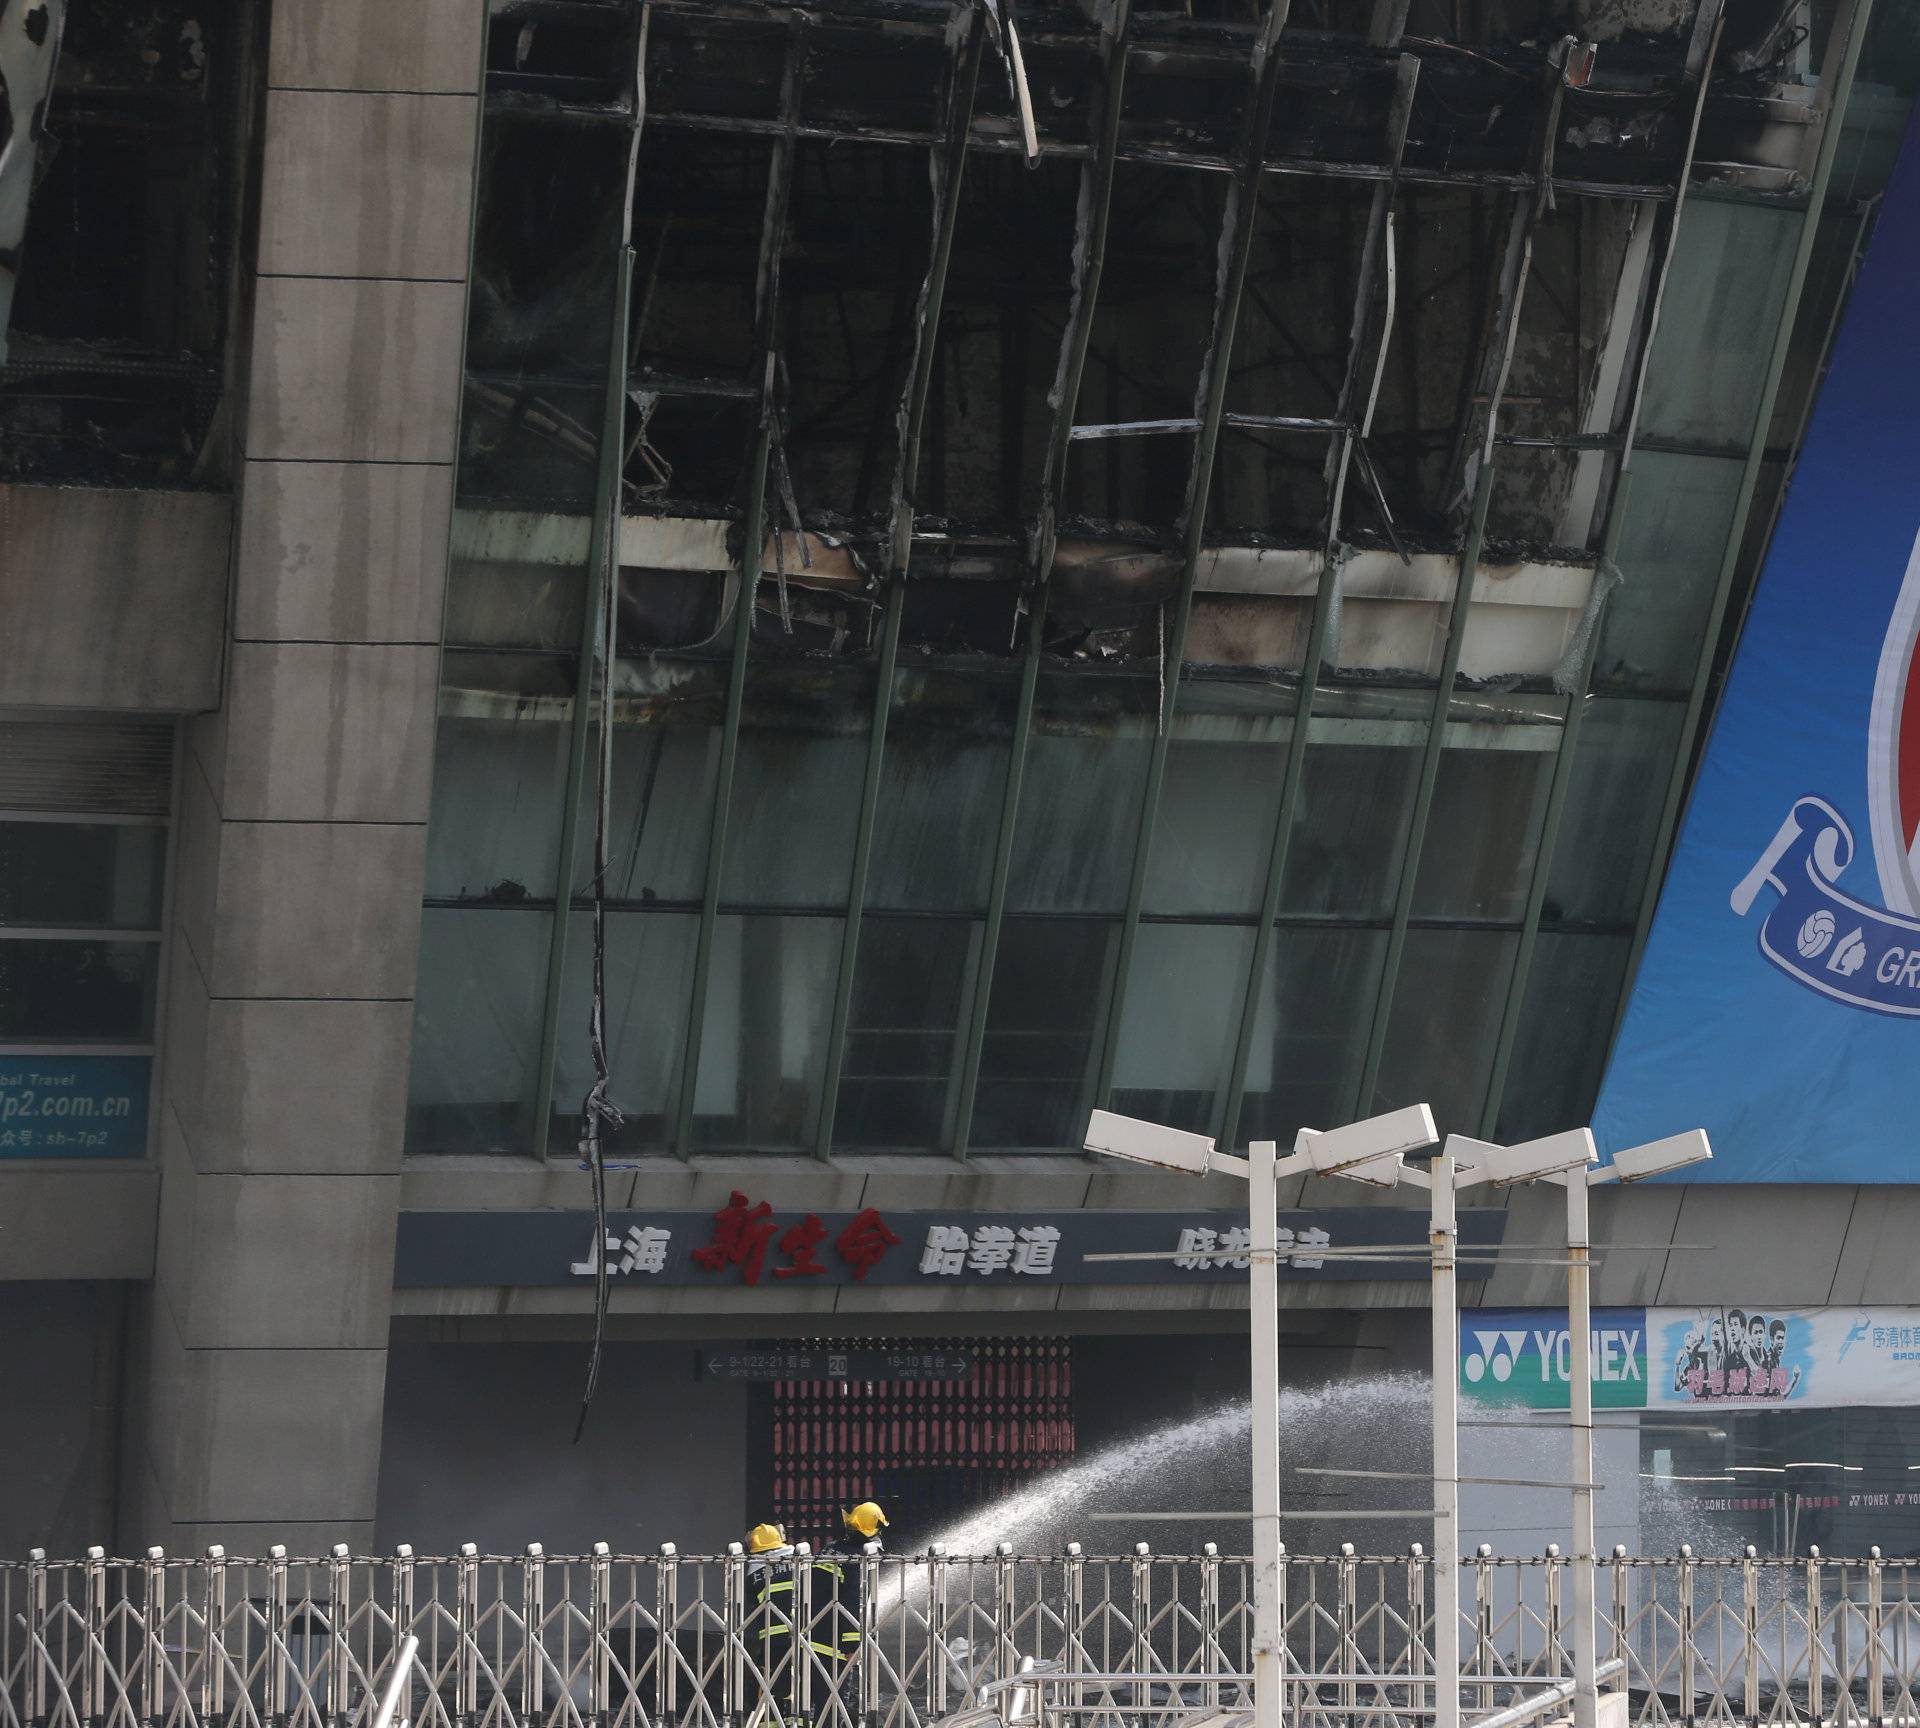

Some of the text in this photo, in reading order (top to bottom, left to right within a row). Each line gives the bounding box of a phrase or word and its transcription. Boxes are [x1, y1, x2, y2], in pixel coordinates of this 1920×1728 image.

[1876, 946, 1920, 989] GR
[30, 1073, 75, 1086] Travel
[570, 1226, 671, 1276] 上海
[690, 1190, 902, 1287] 新生命
[919, 1225, 1061, 1276] 跆拳道
[831, 1358, 847, 1373] 20
[1863, 1494, 1889, 1506] YONEX
[1908, 1493, 1920, 1505] YO
